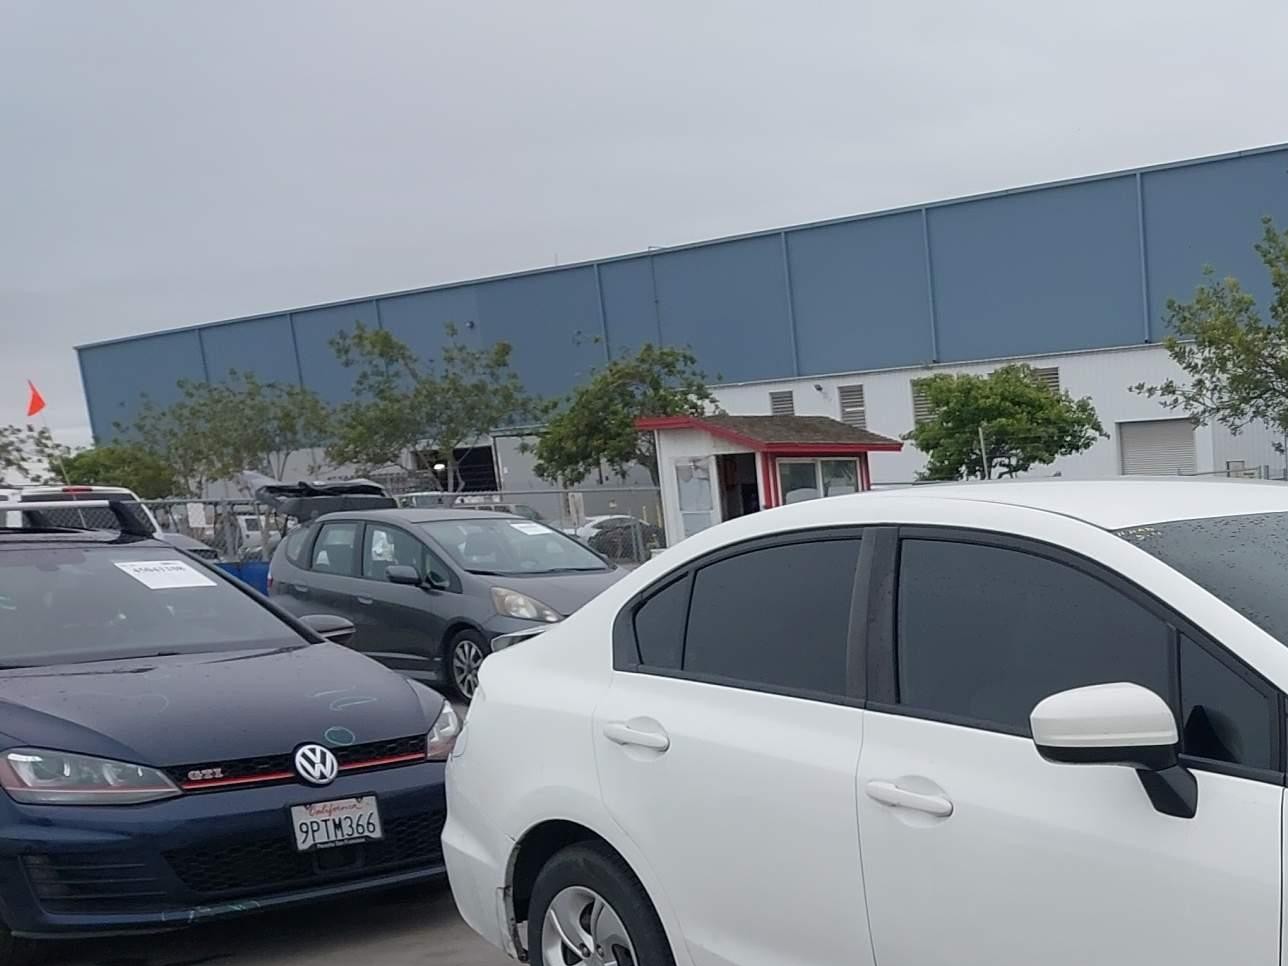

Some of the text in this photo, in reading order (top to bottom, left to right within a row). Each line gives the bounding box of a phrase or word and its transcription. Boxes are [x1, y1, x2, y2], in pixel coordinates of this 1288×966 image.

[187, 767, 224, 780] GTI
[308, 801, 363, 817] California
[299, 811, 377, 845] 9PTM366
